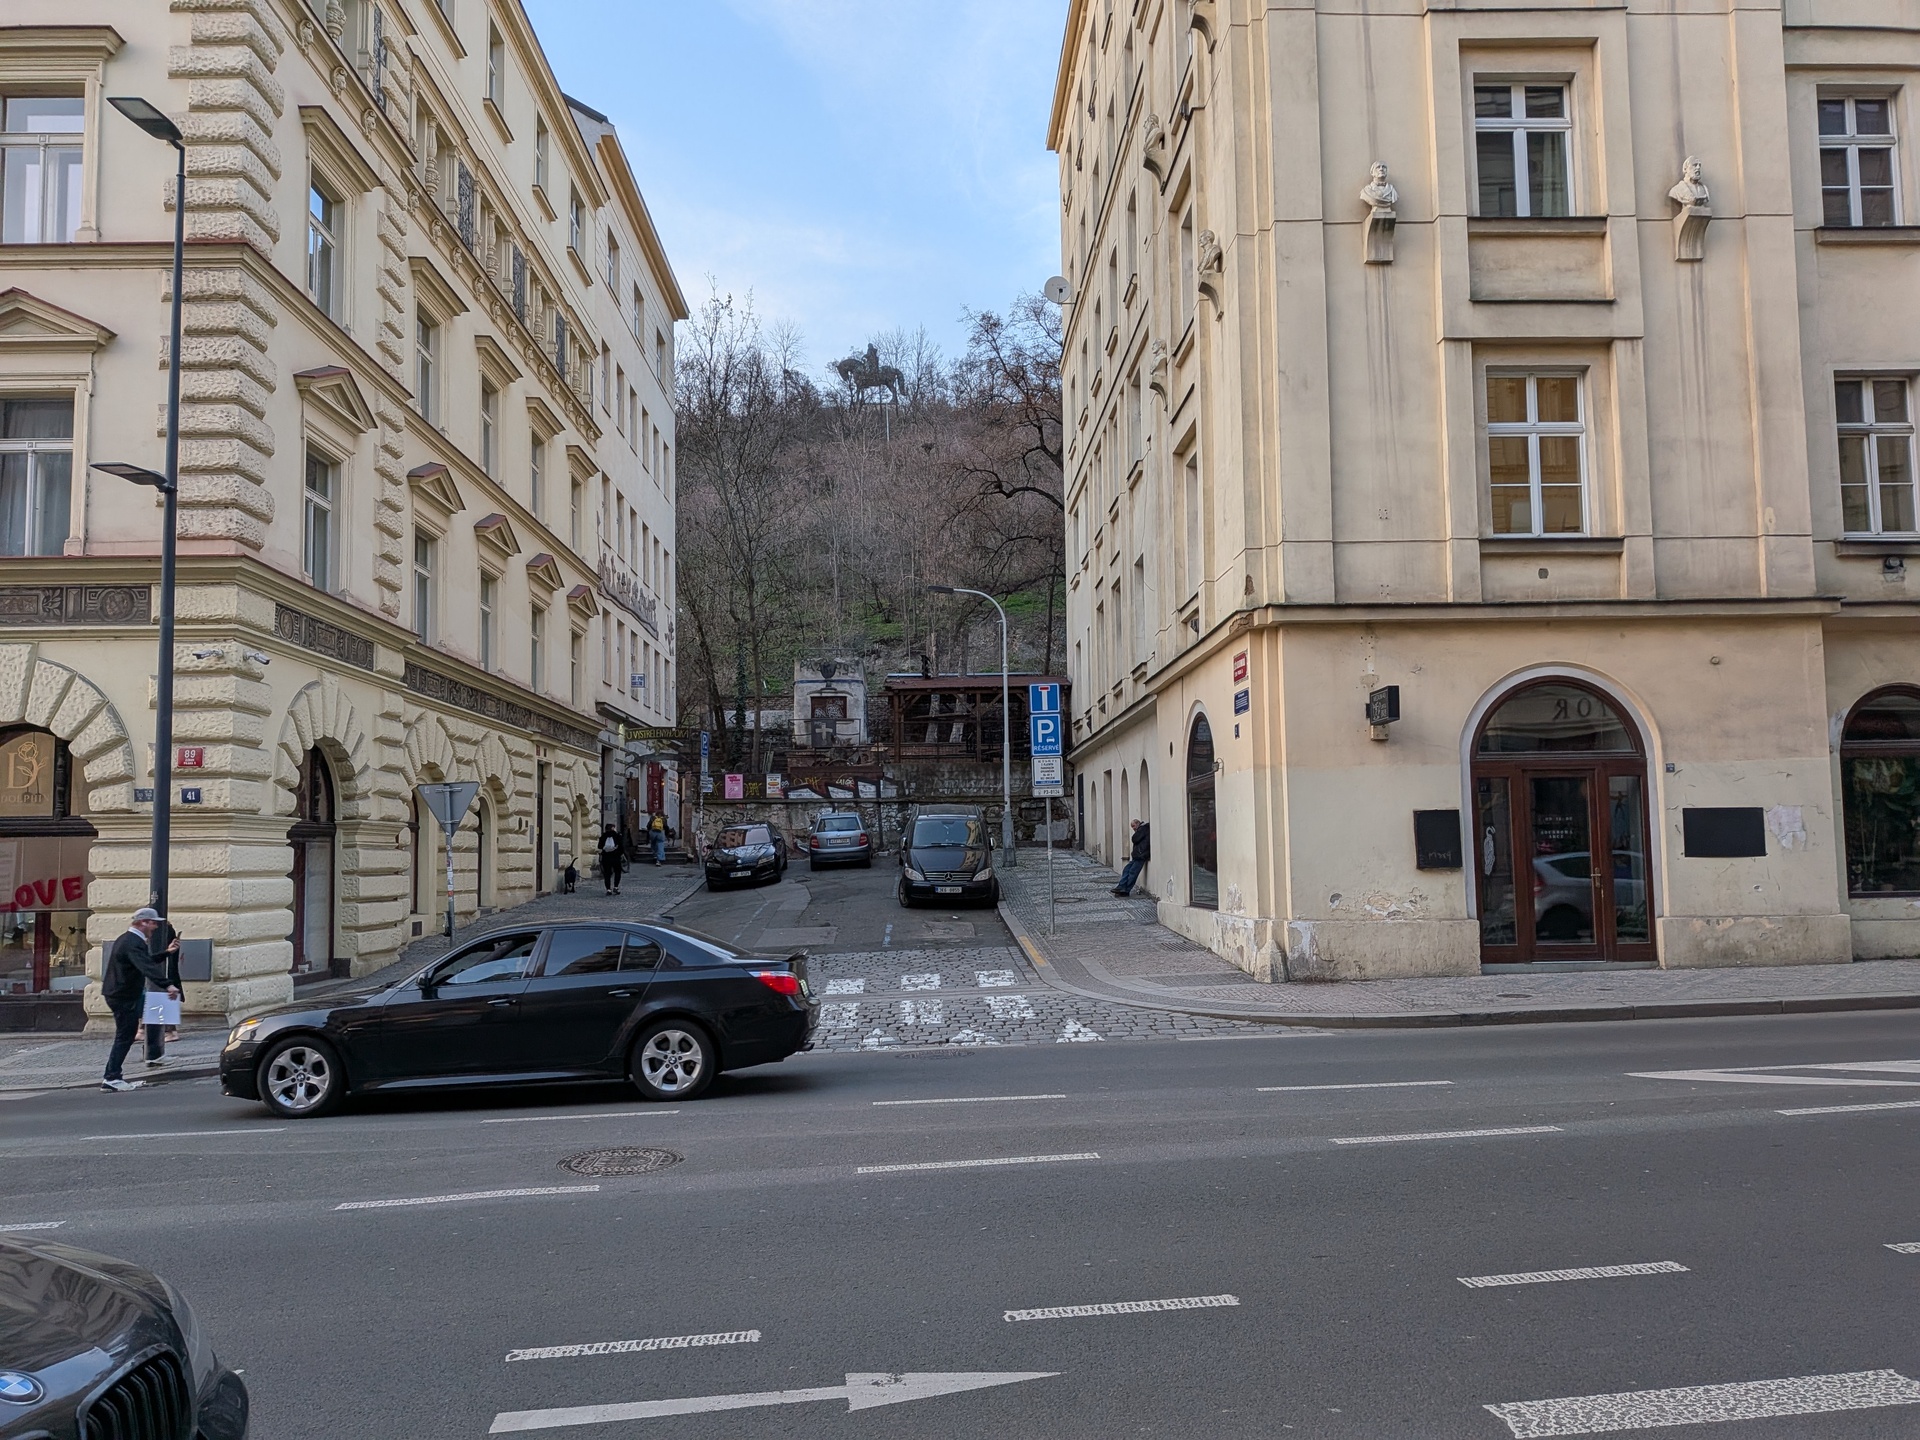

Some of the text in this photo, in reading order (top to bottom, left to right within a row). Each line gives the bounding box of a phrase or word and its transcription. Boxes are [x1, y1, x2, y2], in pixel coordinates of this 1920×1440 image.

[1037, 719, 1054, 743] P
[184, 750, 196, 758] 89
[186, 791, 196, 801] 41
